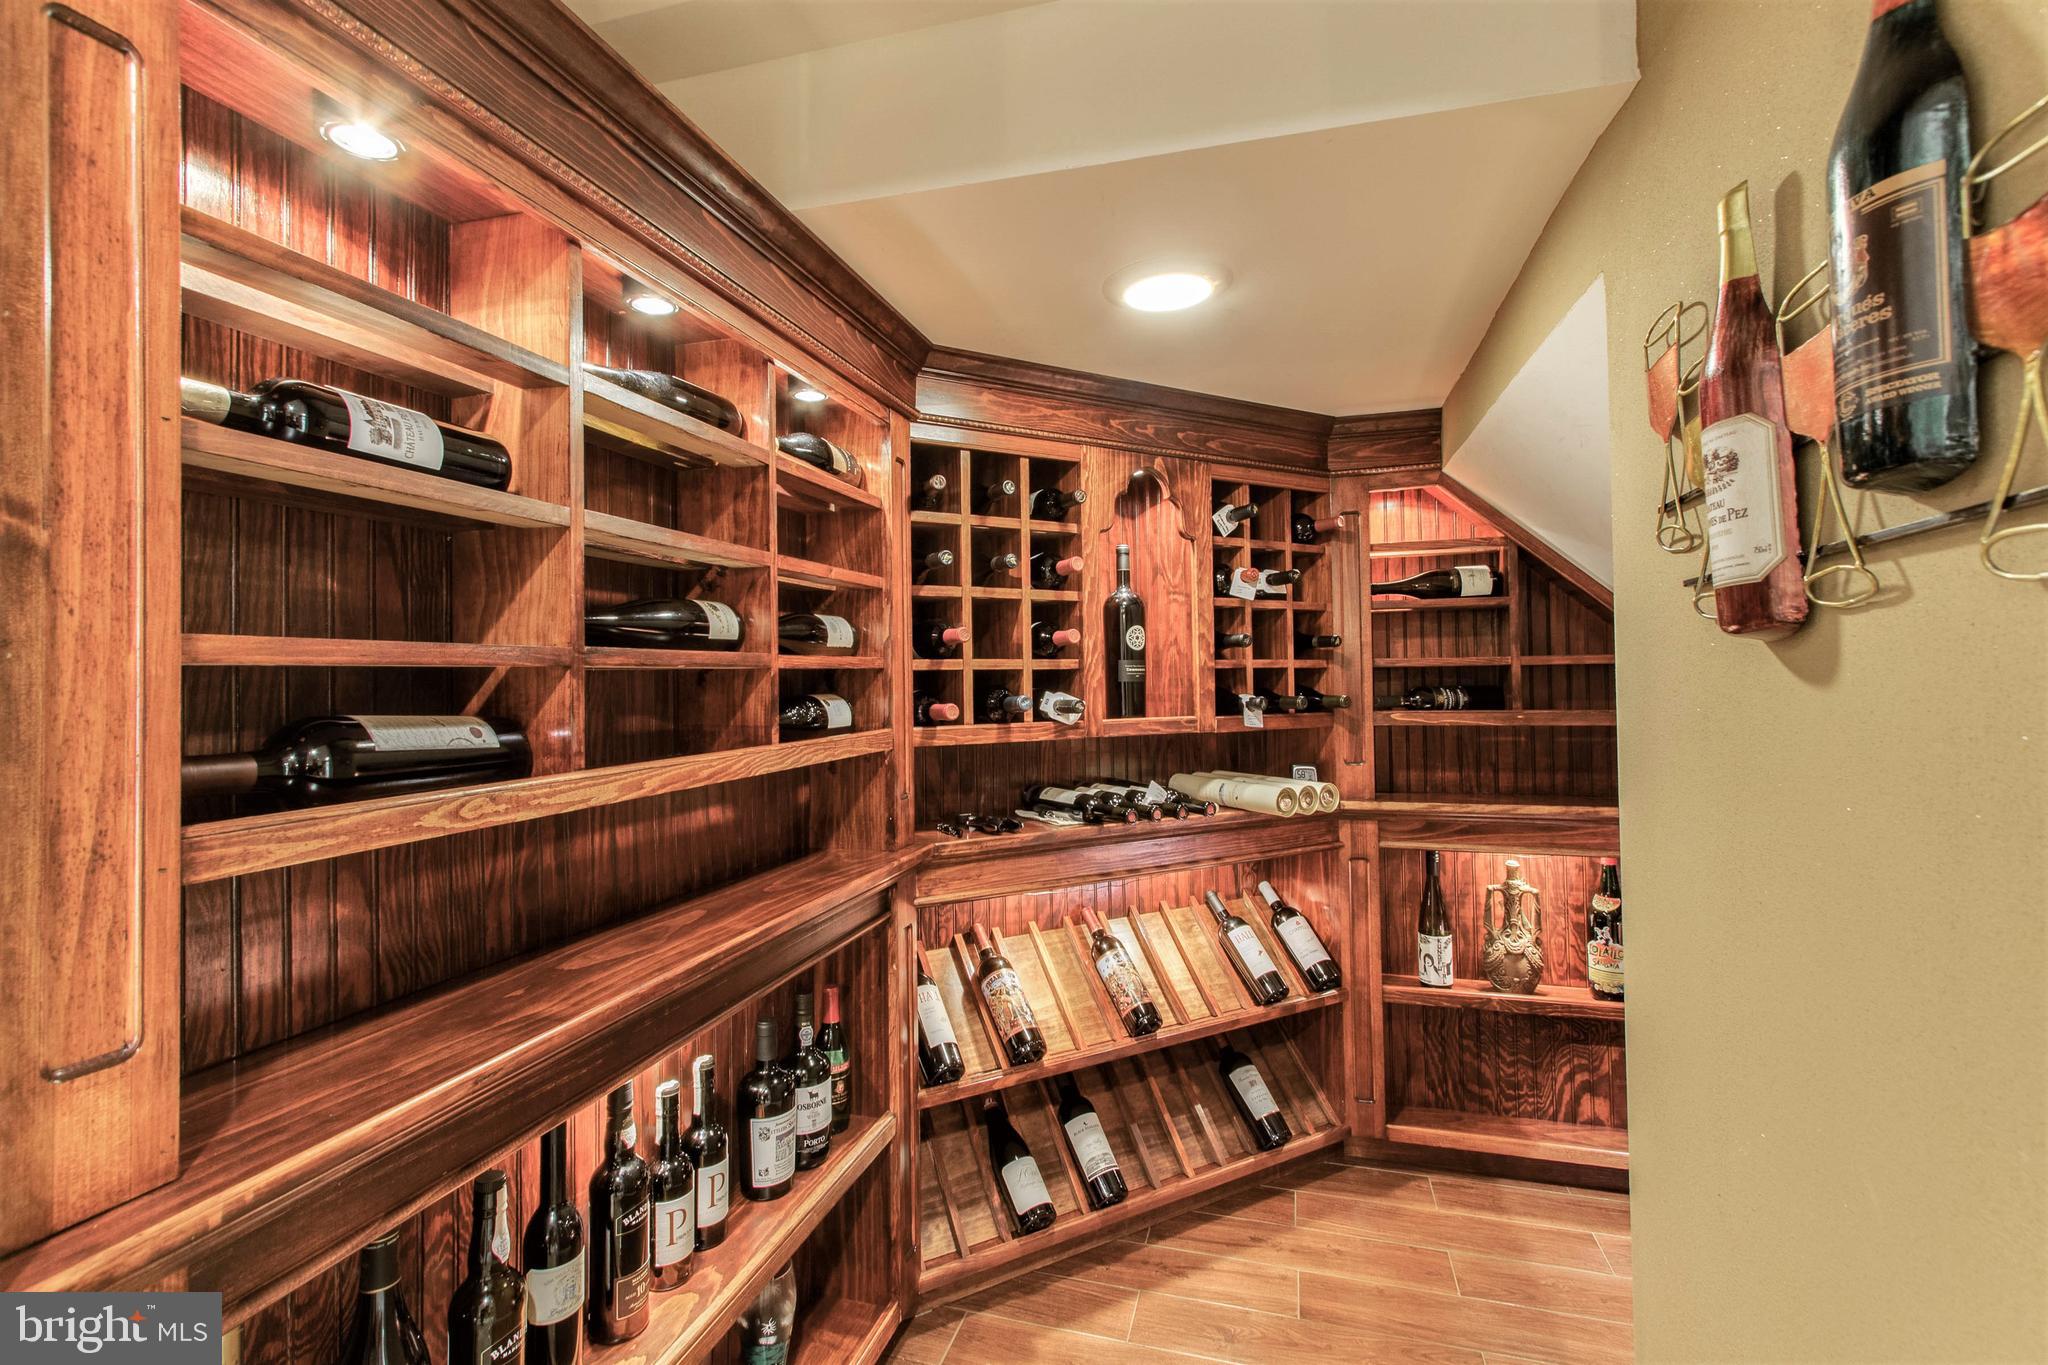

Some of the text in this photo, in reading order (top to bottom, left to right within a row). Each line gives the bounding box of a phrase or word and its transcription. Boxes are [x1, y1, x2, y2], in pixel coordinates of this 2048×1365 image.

[1727, 507, 1749, 521] PEZ
[796, 1096, 827, 1112] OSBORNE
[803, 1135, 826, 1149] PORTO
[708, 1172, 726, 1210] P
[666, 1208, 688, 1247] P
